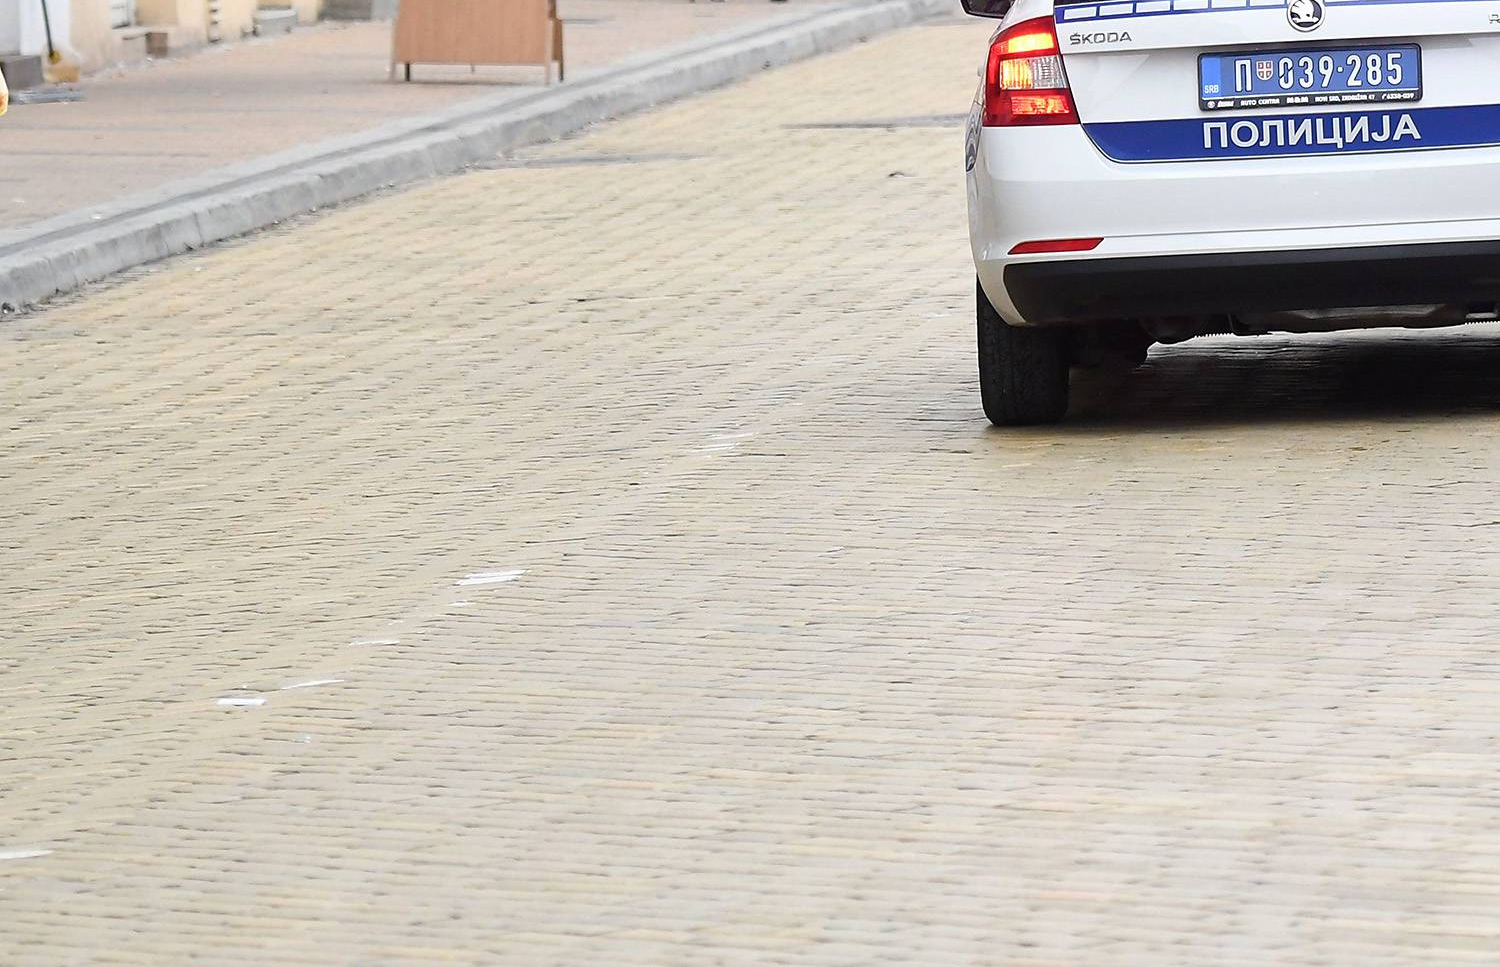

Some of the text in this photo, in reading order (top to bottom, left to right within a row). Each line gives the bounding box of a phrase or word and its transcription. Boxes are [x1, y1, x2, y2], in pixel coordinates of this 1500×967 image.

[1069, 31, 1132, 46] ŠKODA
[1234, 58, 1253, 92] П
[1204, 84, 1220, 94] SRB
[1202, 113, 1422, 149] ПОЛИЦИЈА
